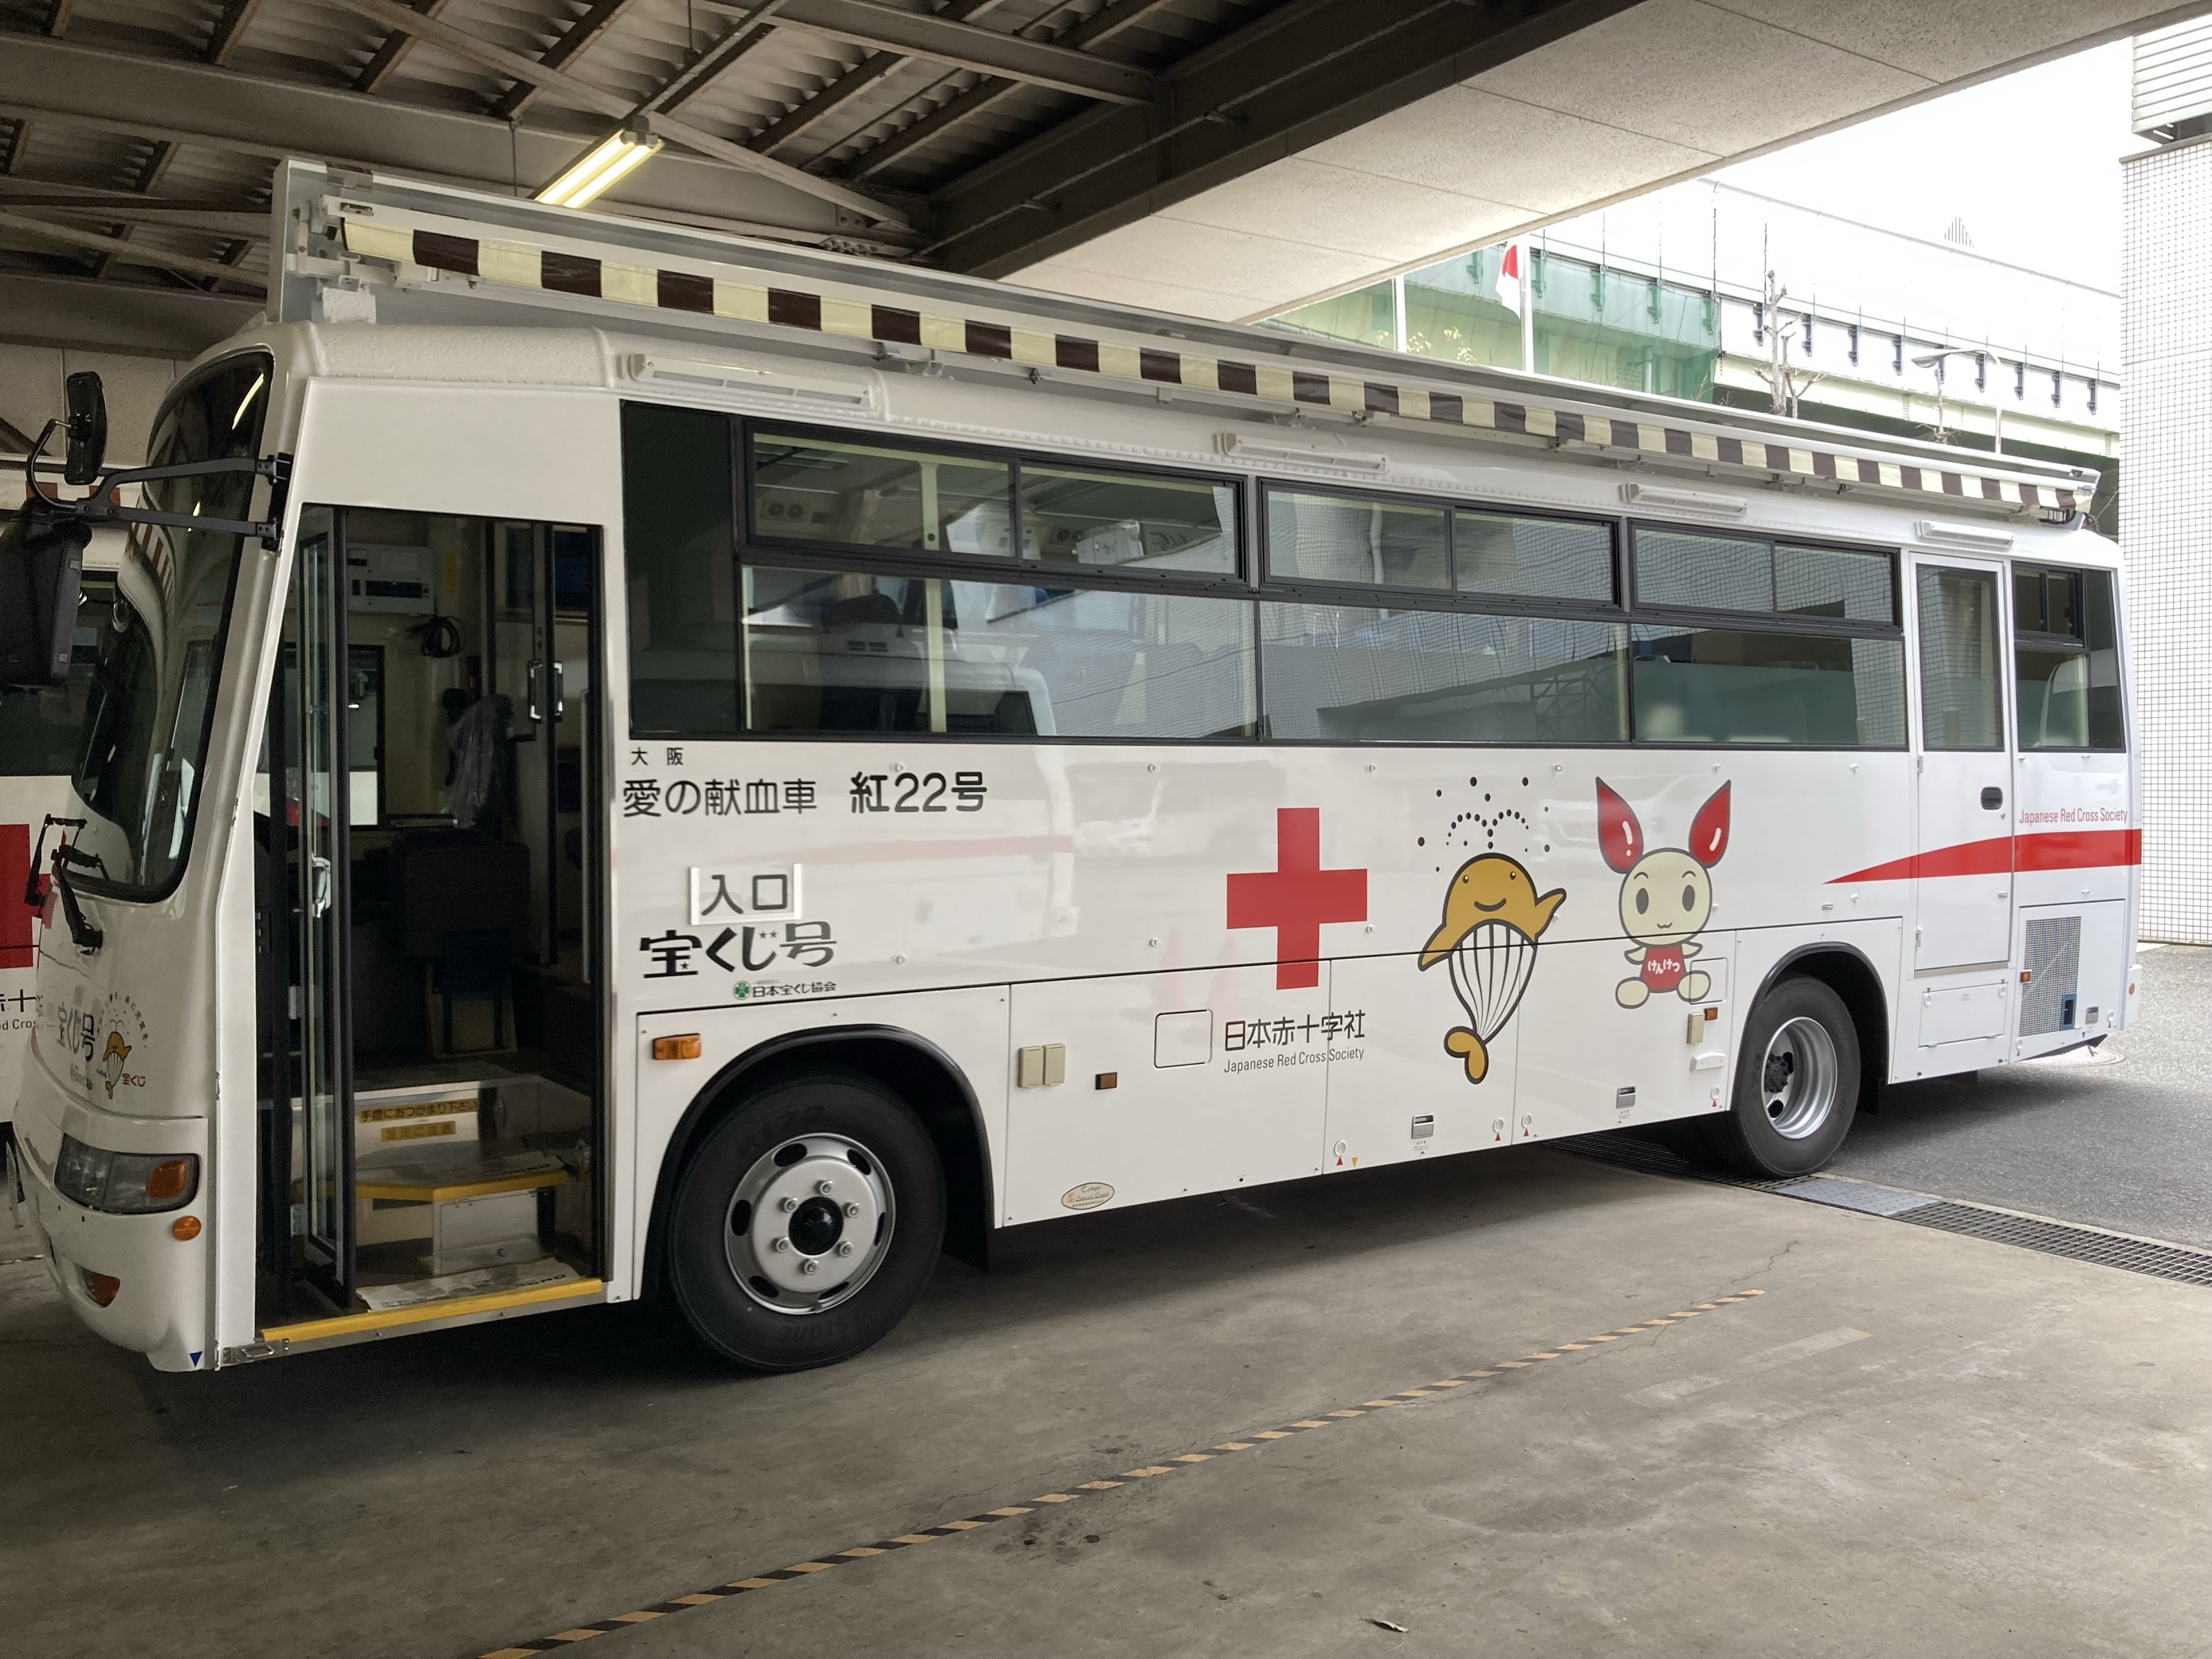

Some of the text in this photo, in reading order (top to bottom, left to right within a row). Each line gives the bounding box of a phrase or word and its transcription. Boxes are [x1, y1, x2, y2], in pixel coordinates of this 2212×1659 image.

[623, 771, 987, 818] 愛の献血車 紅22号
[2019, 807, 2128, 826] Japanese Red Cross Society
[702, 874, 788, 916] 入口
[640, 921, 837, 979] 宝くじ号
[1647, 959, 1681, 975] けんけつ
[753, 981, 837, 998] 日本宝くじ協会
[1224, 1009, 1366, 1051] 日本赤十字社
[1224, 1046, 1365, 1074] Japanese Red Cross Society
